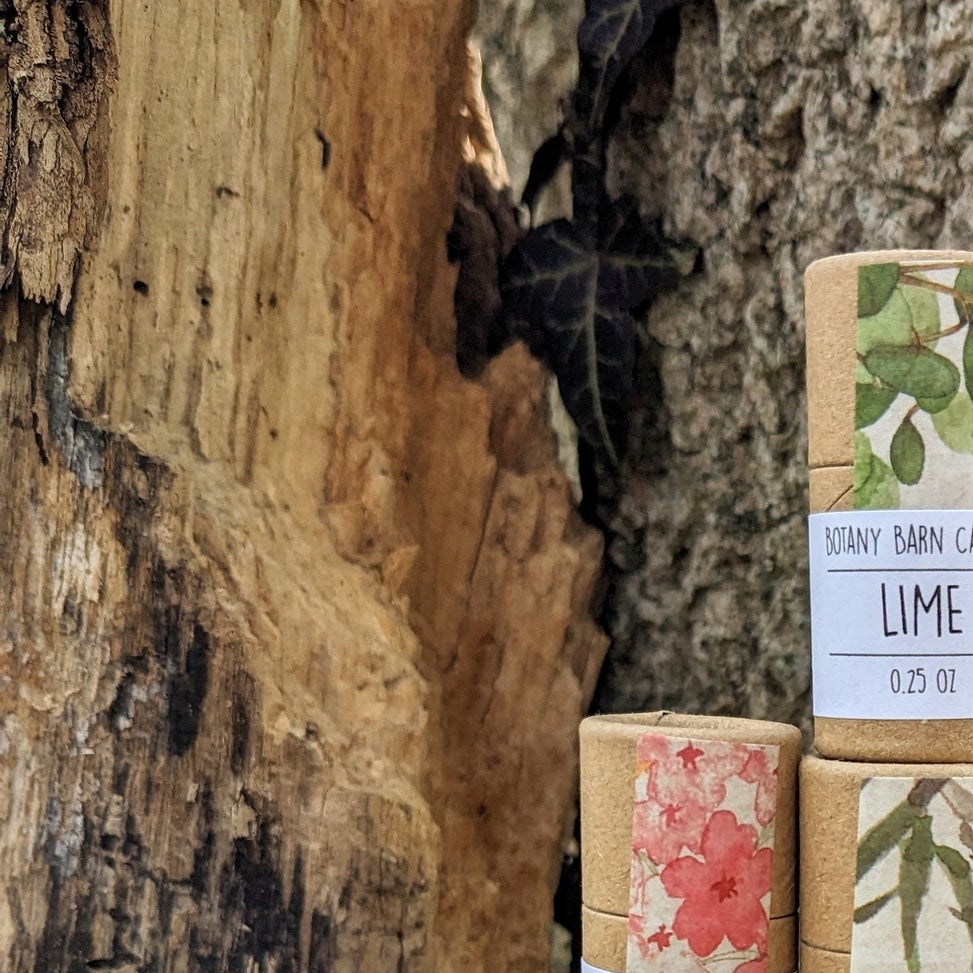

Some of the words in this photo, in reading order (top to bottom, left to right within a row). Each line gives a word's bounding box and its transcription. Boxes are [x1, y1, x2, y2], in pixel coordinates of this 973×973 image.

[825, 527, 882, 556] BOTANY
[894, 524, 944, 555] BARN
[882, 583, 962, 637] LIME
[890, 668, 926, 694] 0.25
[937, 669, 956, 693] OZ
